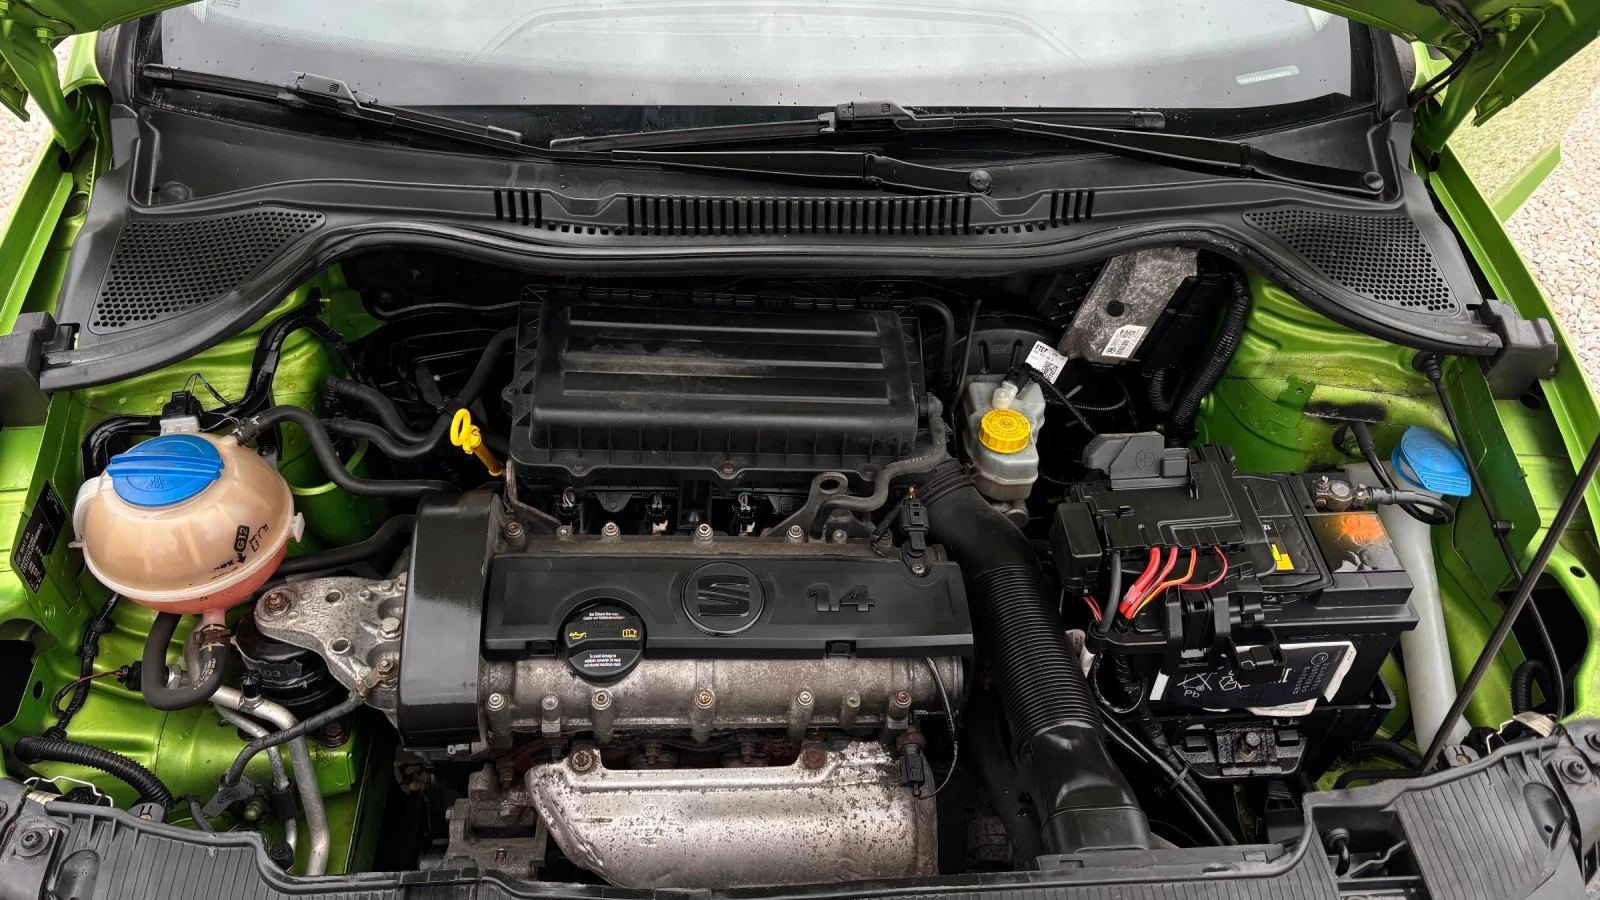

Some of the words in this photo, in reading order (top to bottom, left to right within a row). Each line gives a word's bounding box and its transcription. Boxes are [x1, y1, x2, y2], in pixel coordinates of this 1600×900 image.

[236, 527, 248, 549] G12
[808, 583, 875, 612] 1.4
[1183, 689, 1200, 698] Pb
